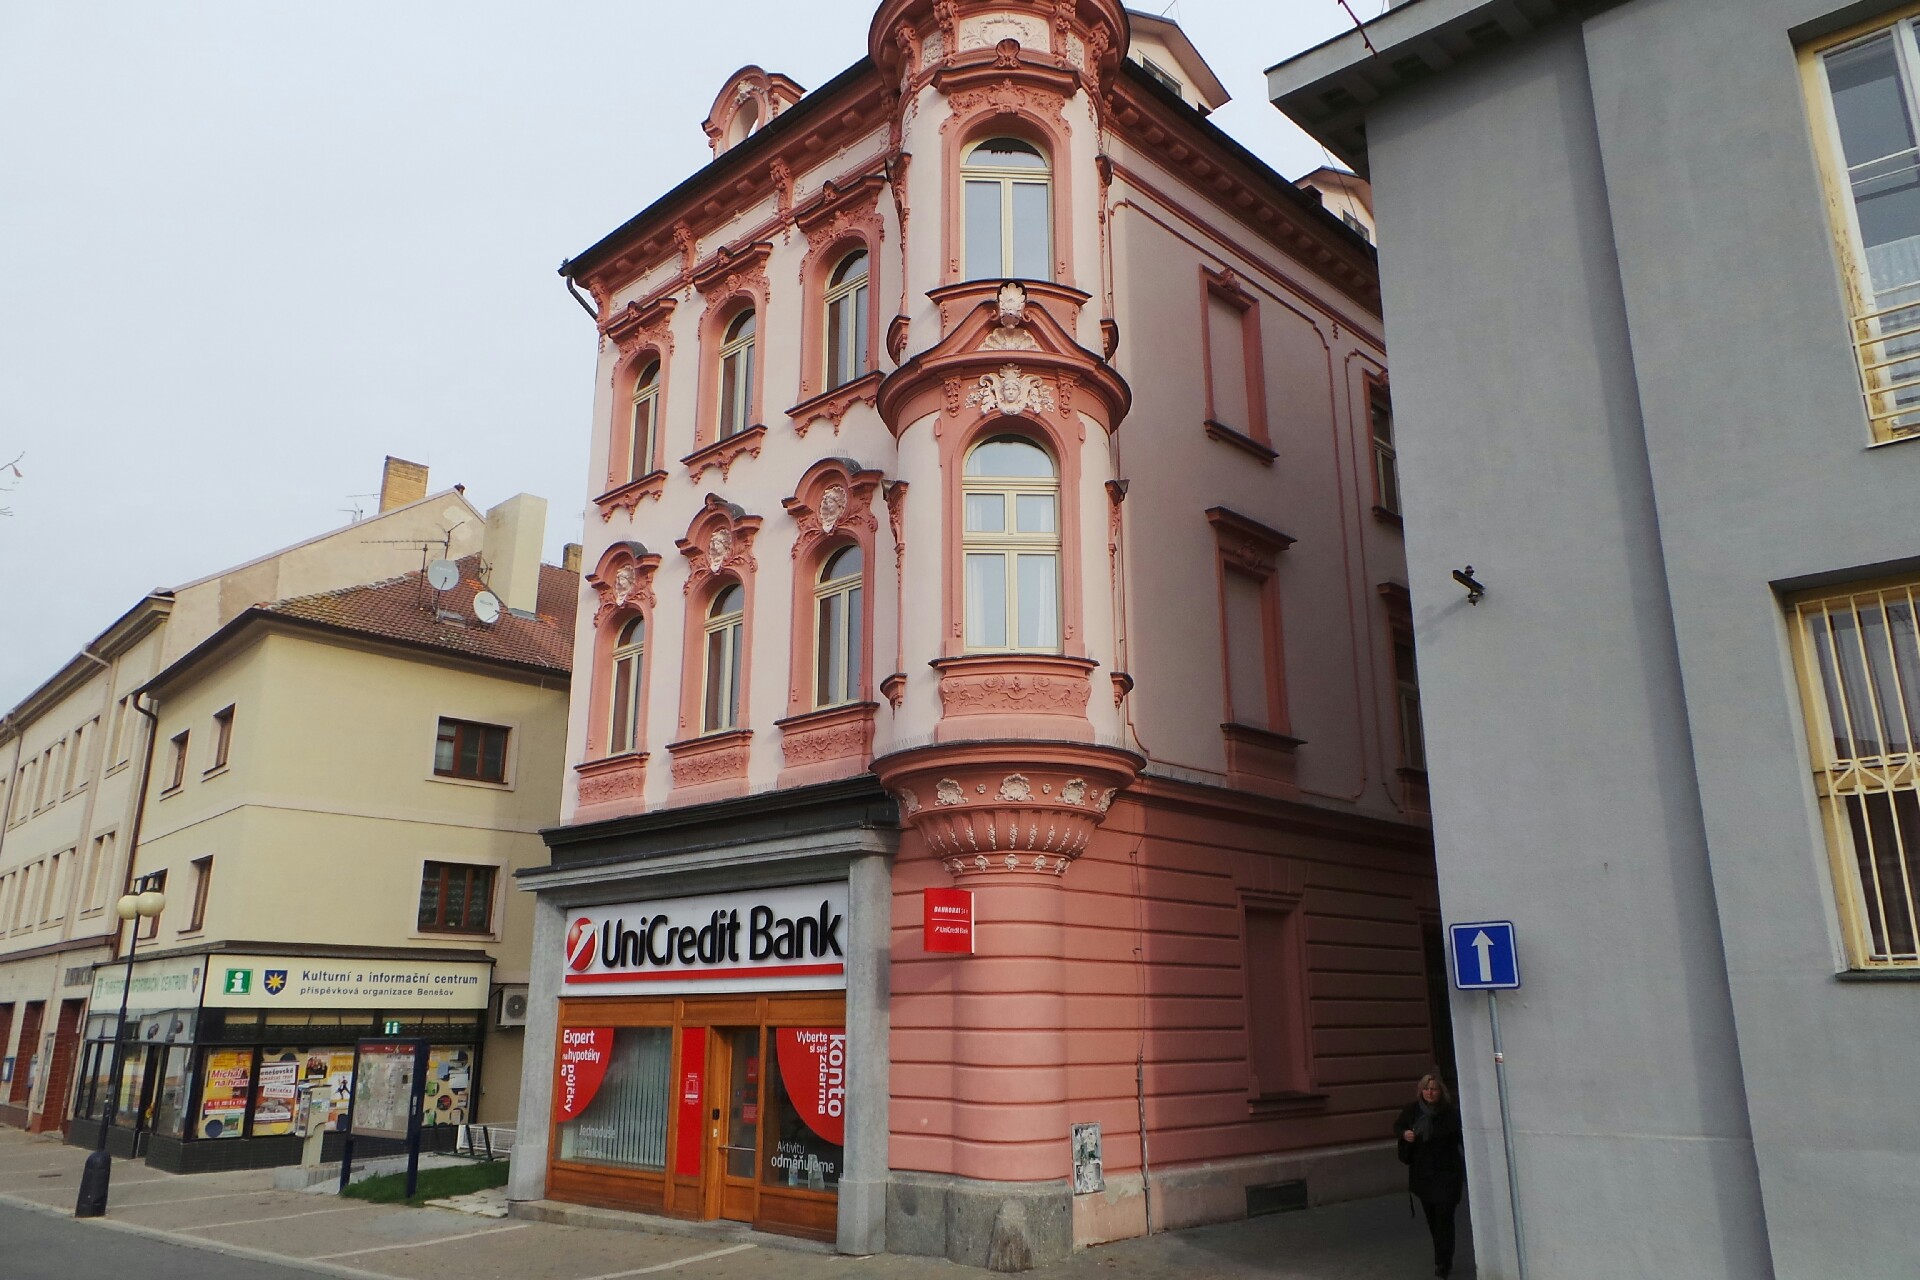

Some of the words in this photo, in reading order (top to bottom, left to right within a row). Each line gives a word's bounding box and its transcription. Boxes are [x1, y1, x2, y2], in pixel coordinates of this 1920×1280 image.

[602, 908, 741, 968] UniCredit
[749, 900, 843, 961] Bank
[302, 970, 352, 982] Kulturní
[356, 973, 363, 982] a
[369, 971, 430, 985] informační
[434, 973, 479, 985] centrum
[299, 986, 360, 996] příspěvková
[362, 986, 413, 997] organizace
[416, 987, 454, 996] Benešov
[563, 1029, 595, 1047] Expert
[796, 1031, 828, 1045] Vyberte
[568, 1047, 600, 1064] hypotéky
[809, 1043, 816, 1054] si
[816, 1044, 828, 1054] své
[260, 1067, 294, 1077] enešovské
[561, 1064, 567, 1077] a
[827, 1034, 846, 1118] konto
[228, 1078, 248, 1088] hran
[563, 1064, 576, 1113] půjčky
[818, 1054, 829, 1115] zdarma
[771, 1154, 835, 1174] odměňujeme
